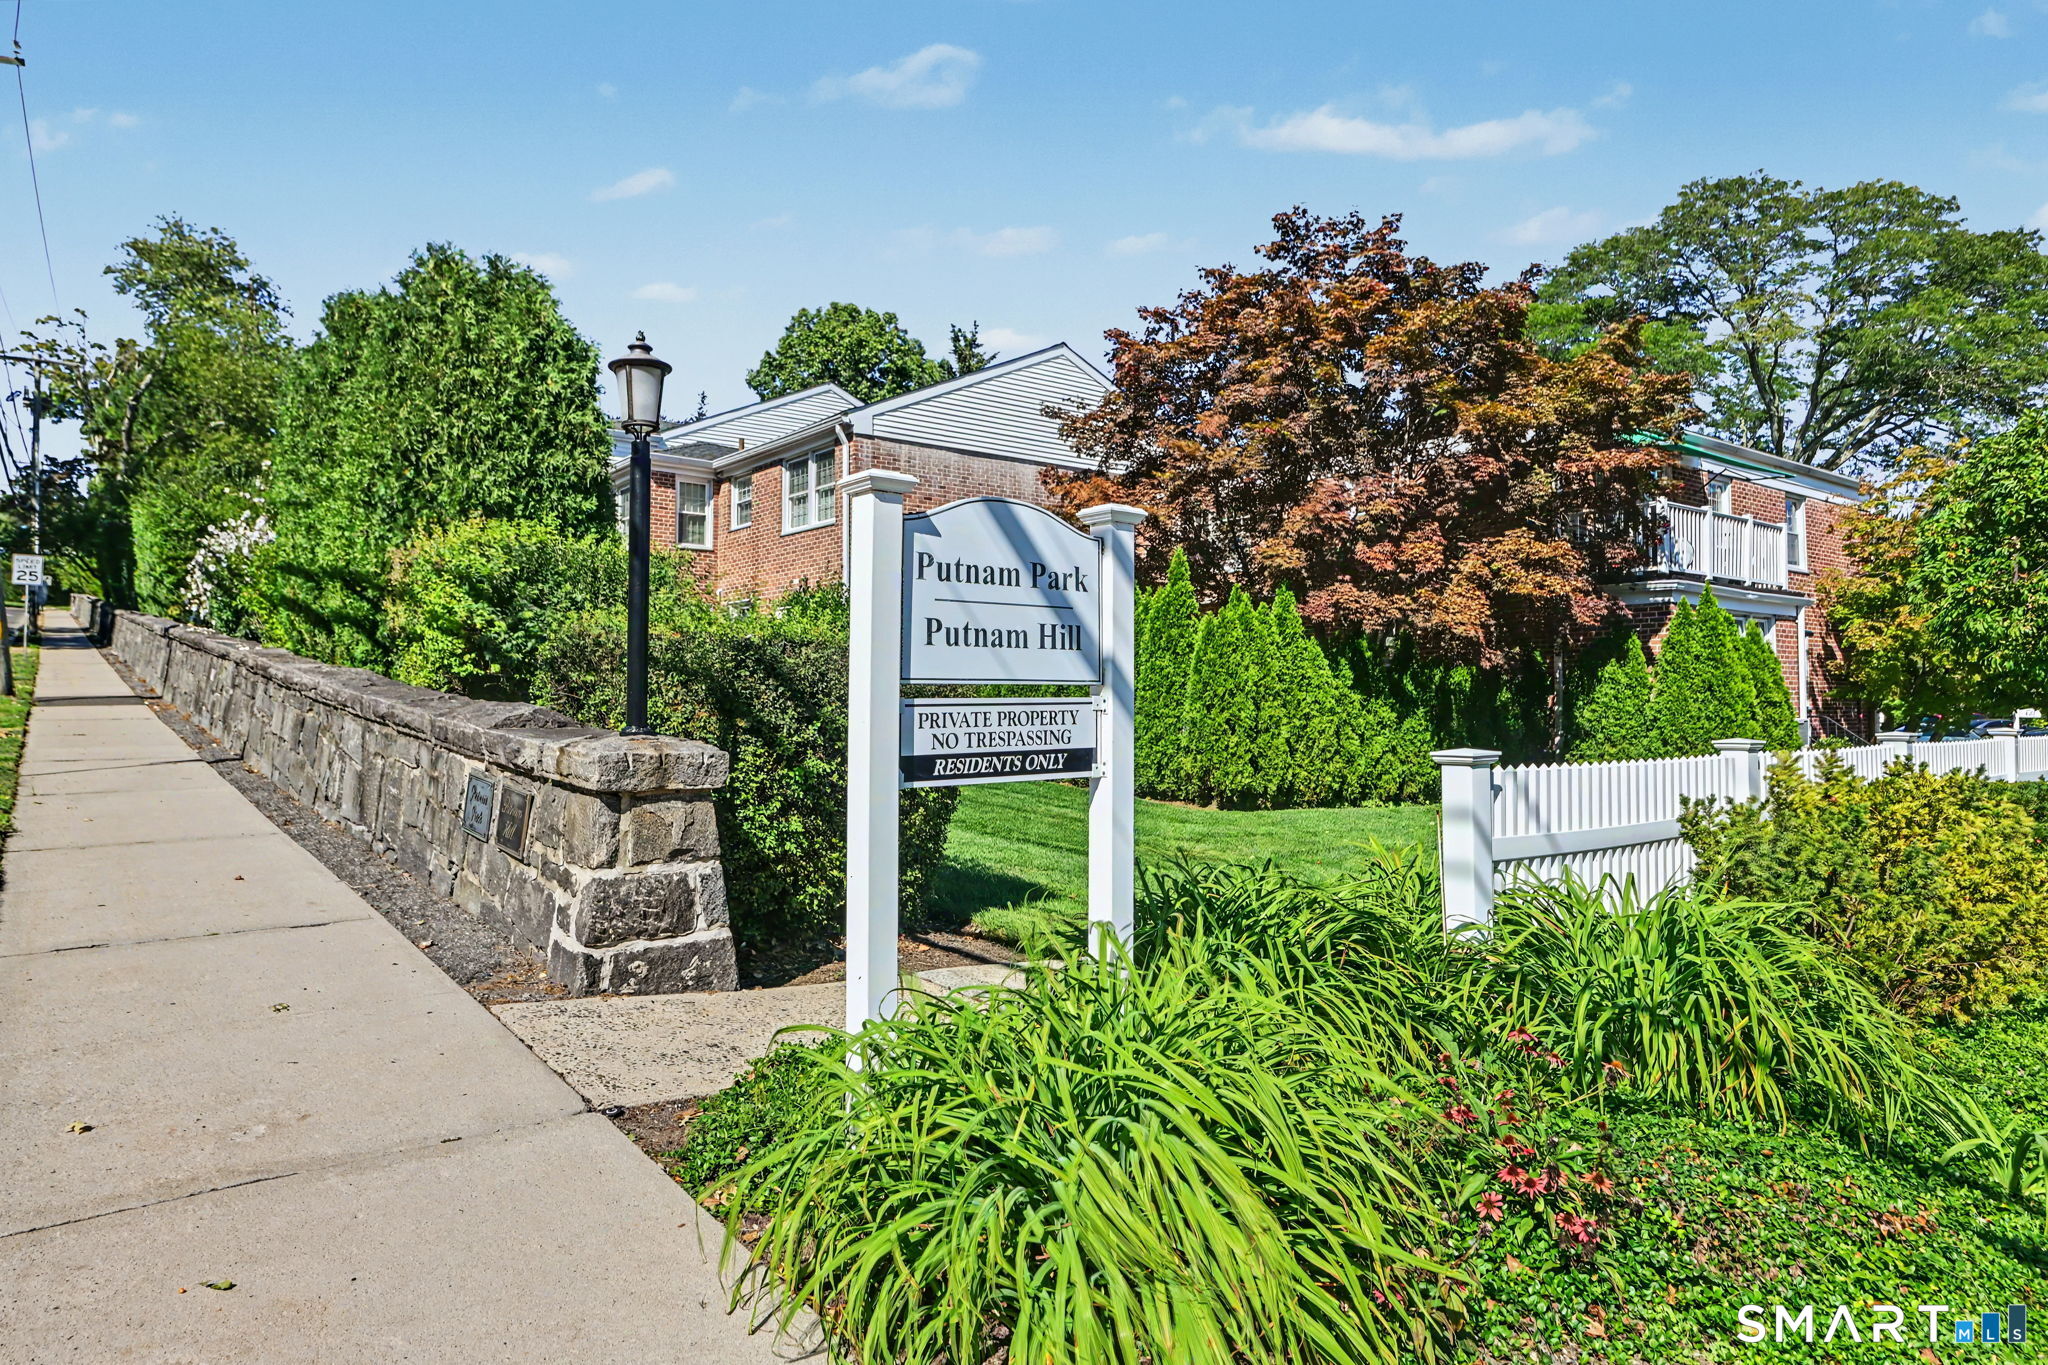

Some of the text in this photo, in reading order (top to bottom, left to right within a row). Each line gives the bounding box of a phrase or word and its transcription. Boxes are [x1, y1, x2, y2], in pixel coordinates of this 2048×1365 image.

[17, 570, 38, 581] 25
[916, 551, 1088, 592] Putnam Park
[924, 617, 1082, 651] Putnam Hill
[918, 710, 1079, 729] PRIVATE PROPERTY
[932, 729, 1071, 750] NO TRESPASSING
[933, 753, 1067, 775] RESIDENTS ONLY
